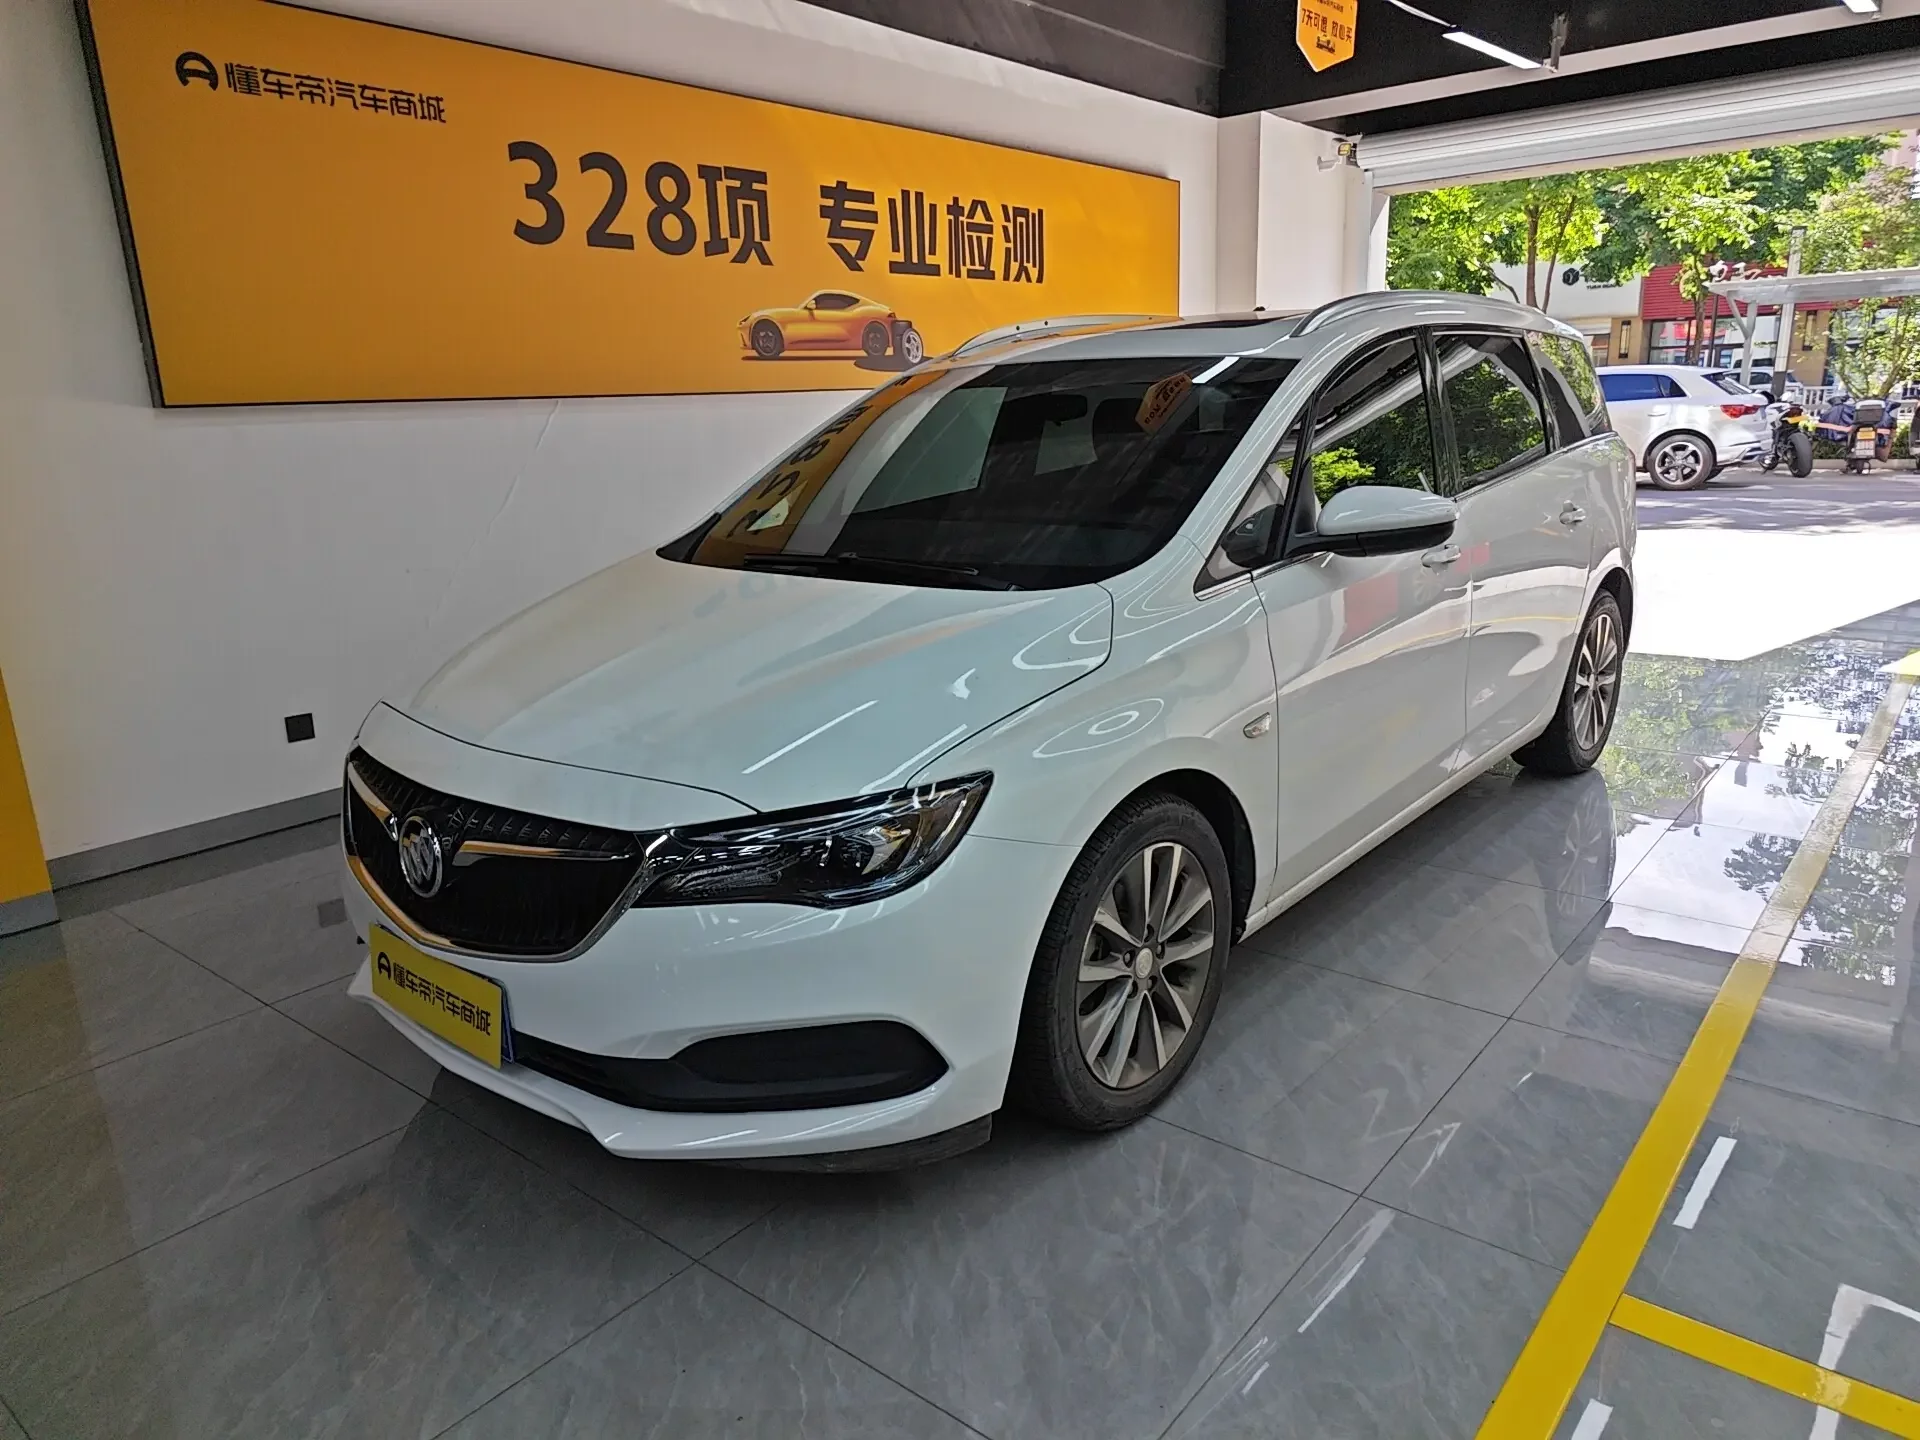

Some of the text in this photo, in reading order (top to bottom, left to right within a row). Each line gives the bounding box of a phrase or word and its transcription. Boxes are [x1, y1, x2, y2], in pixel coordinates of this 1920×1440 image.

[224, 62, 447, 124] 懂车帝汽车商城
[507, 141, 1045, 284] 328项 专业检测
[393, 962, 491, 1036] 懂车帝汽车商城
